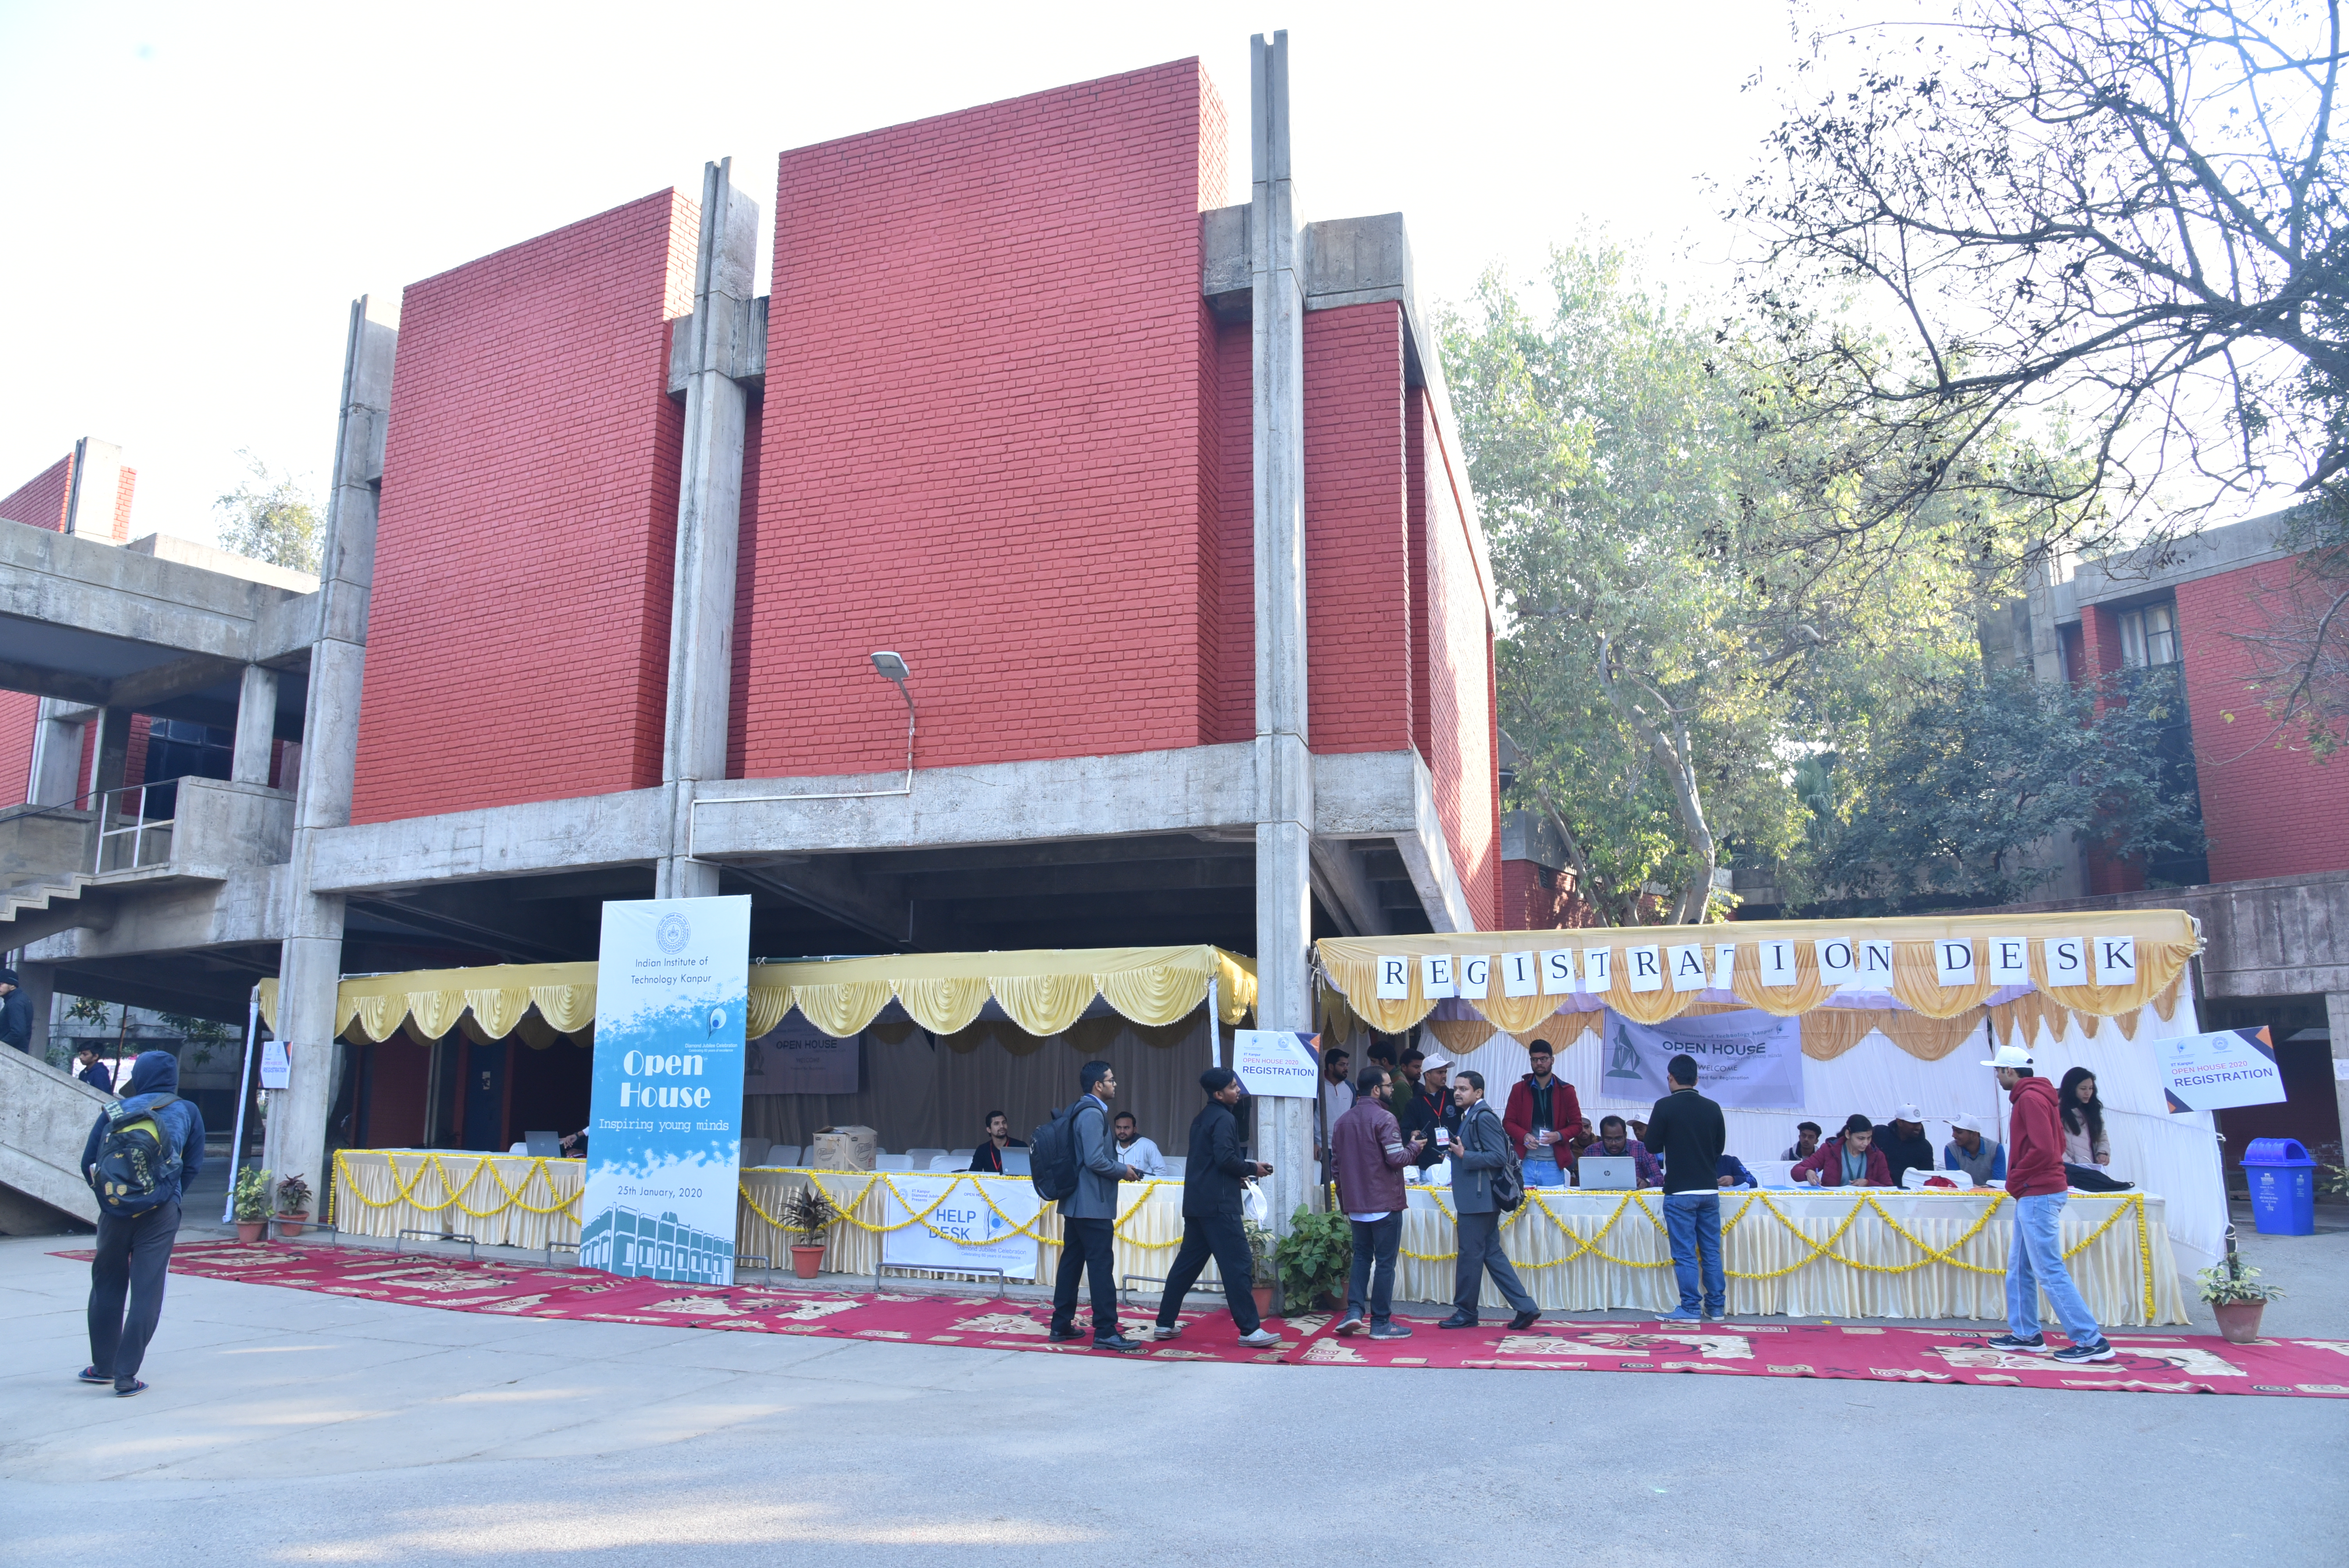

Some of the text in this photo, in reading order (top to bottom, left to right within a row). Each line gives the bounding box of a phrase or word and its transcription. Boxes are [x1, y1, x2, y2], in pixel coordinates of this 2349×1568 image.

[635, 956, 708, 968] Indian Institute of
[1945, 942, 2134, 971] DESK
[631, 974, 711, 985] Technology Kanpur
[1752, 1028, 1773, 1036] Kanpur
[776, 1039, 837, 1049] OPEN HOUSE
[1662, 1041, 1766, 1056] OPEN HOUSE
[624, 1050, 703, 1076] Open
[1697, 1064, 1738, 1072] WELCOME
[2171, 1067, 2195, 1075] OPEN
[2197, 1063, 2227, 1072] HOUSE
[1242, 1066, 1314, 1077] REGISTRATION
[2174, 1067, 2273, 1087] REGISTRATION
[620, 1082, 711, 1108] House
[599, 1118, 729, 1133] Inspiring young minds
[618, 1185, 702, 1199] 25th January, 2020
[936, 1208, 976, 1223] HELP
